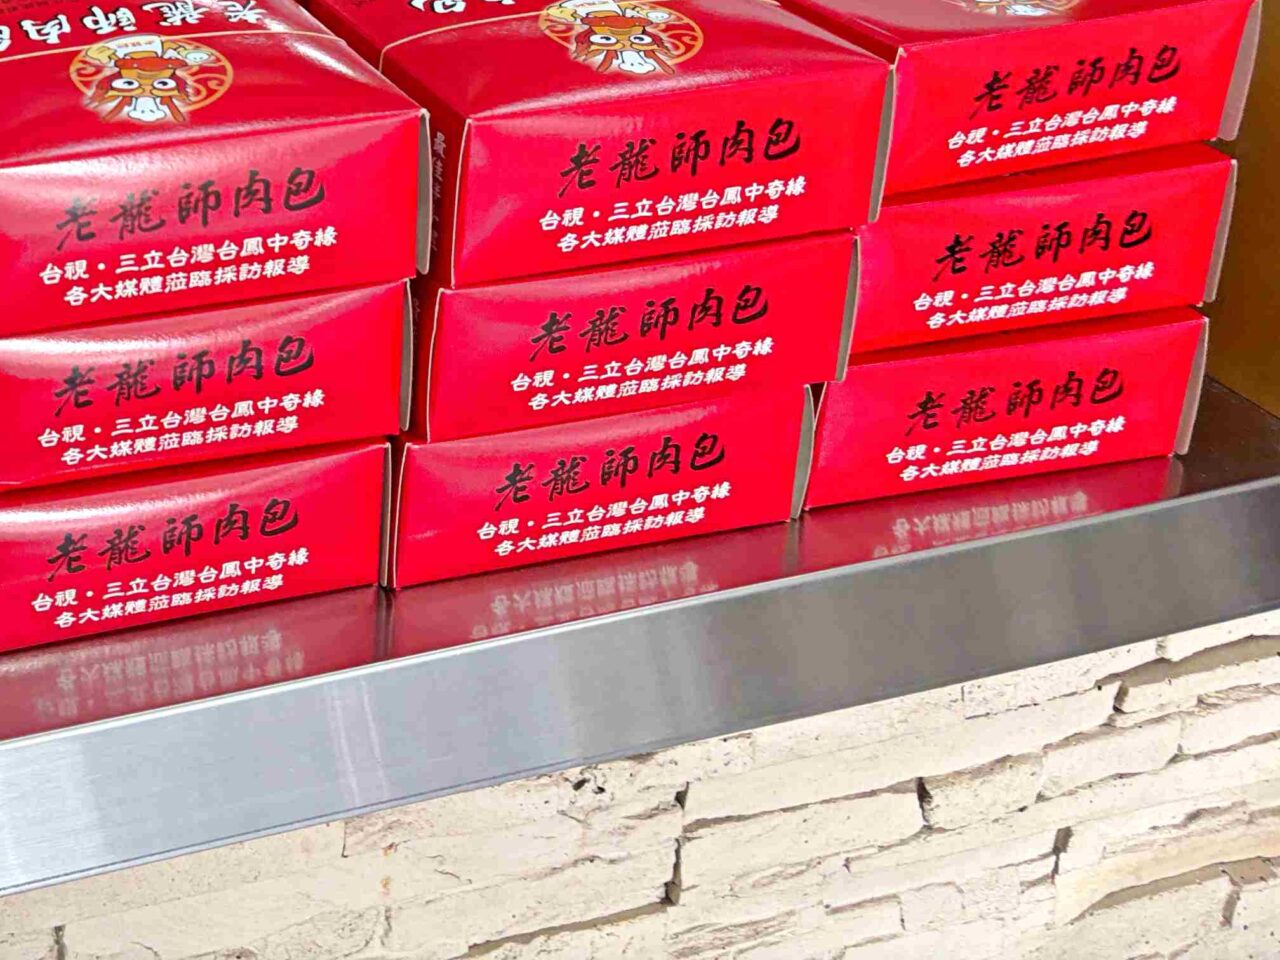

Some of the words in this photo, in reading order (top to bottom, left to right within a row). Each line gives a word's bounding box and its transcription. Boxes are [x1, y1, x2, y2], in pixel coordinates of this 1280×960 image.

[970, 44, 1182, 120] 老龍師肉包
[557, 117, 802, 198] 老龍師肉包
[55, 167, 326, 252] 老龍師肉包
[556, 204, 780, 253] 各大媒體蒞臨採訪報導
[932, 209, 1153, 283] 老龍師肉包
[63, 255, 311, 307] 各大媒體蒞臨採訪報導
[530, 285, 769, 363] 老龍師肉包
[53, 335, 316, 420] 老龍師肉包
[527, 364, 747, 411] 各大媒體蒞臨採訪報導
[904, 367, 1125, 438] 老龍師肉包
[60, 414, 300, 467] 各大媒體蒞臨採訪報導
[494, 432, 726, 513] 老龍師肉包
[47, 497, 300, 584] 老龍師肉包
[494, 506, 706, 558] 各大媒體蒞臨採訪報導
[54, 574, 285, 630] 各大媒體蒞臨採訪報導
